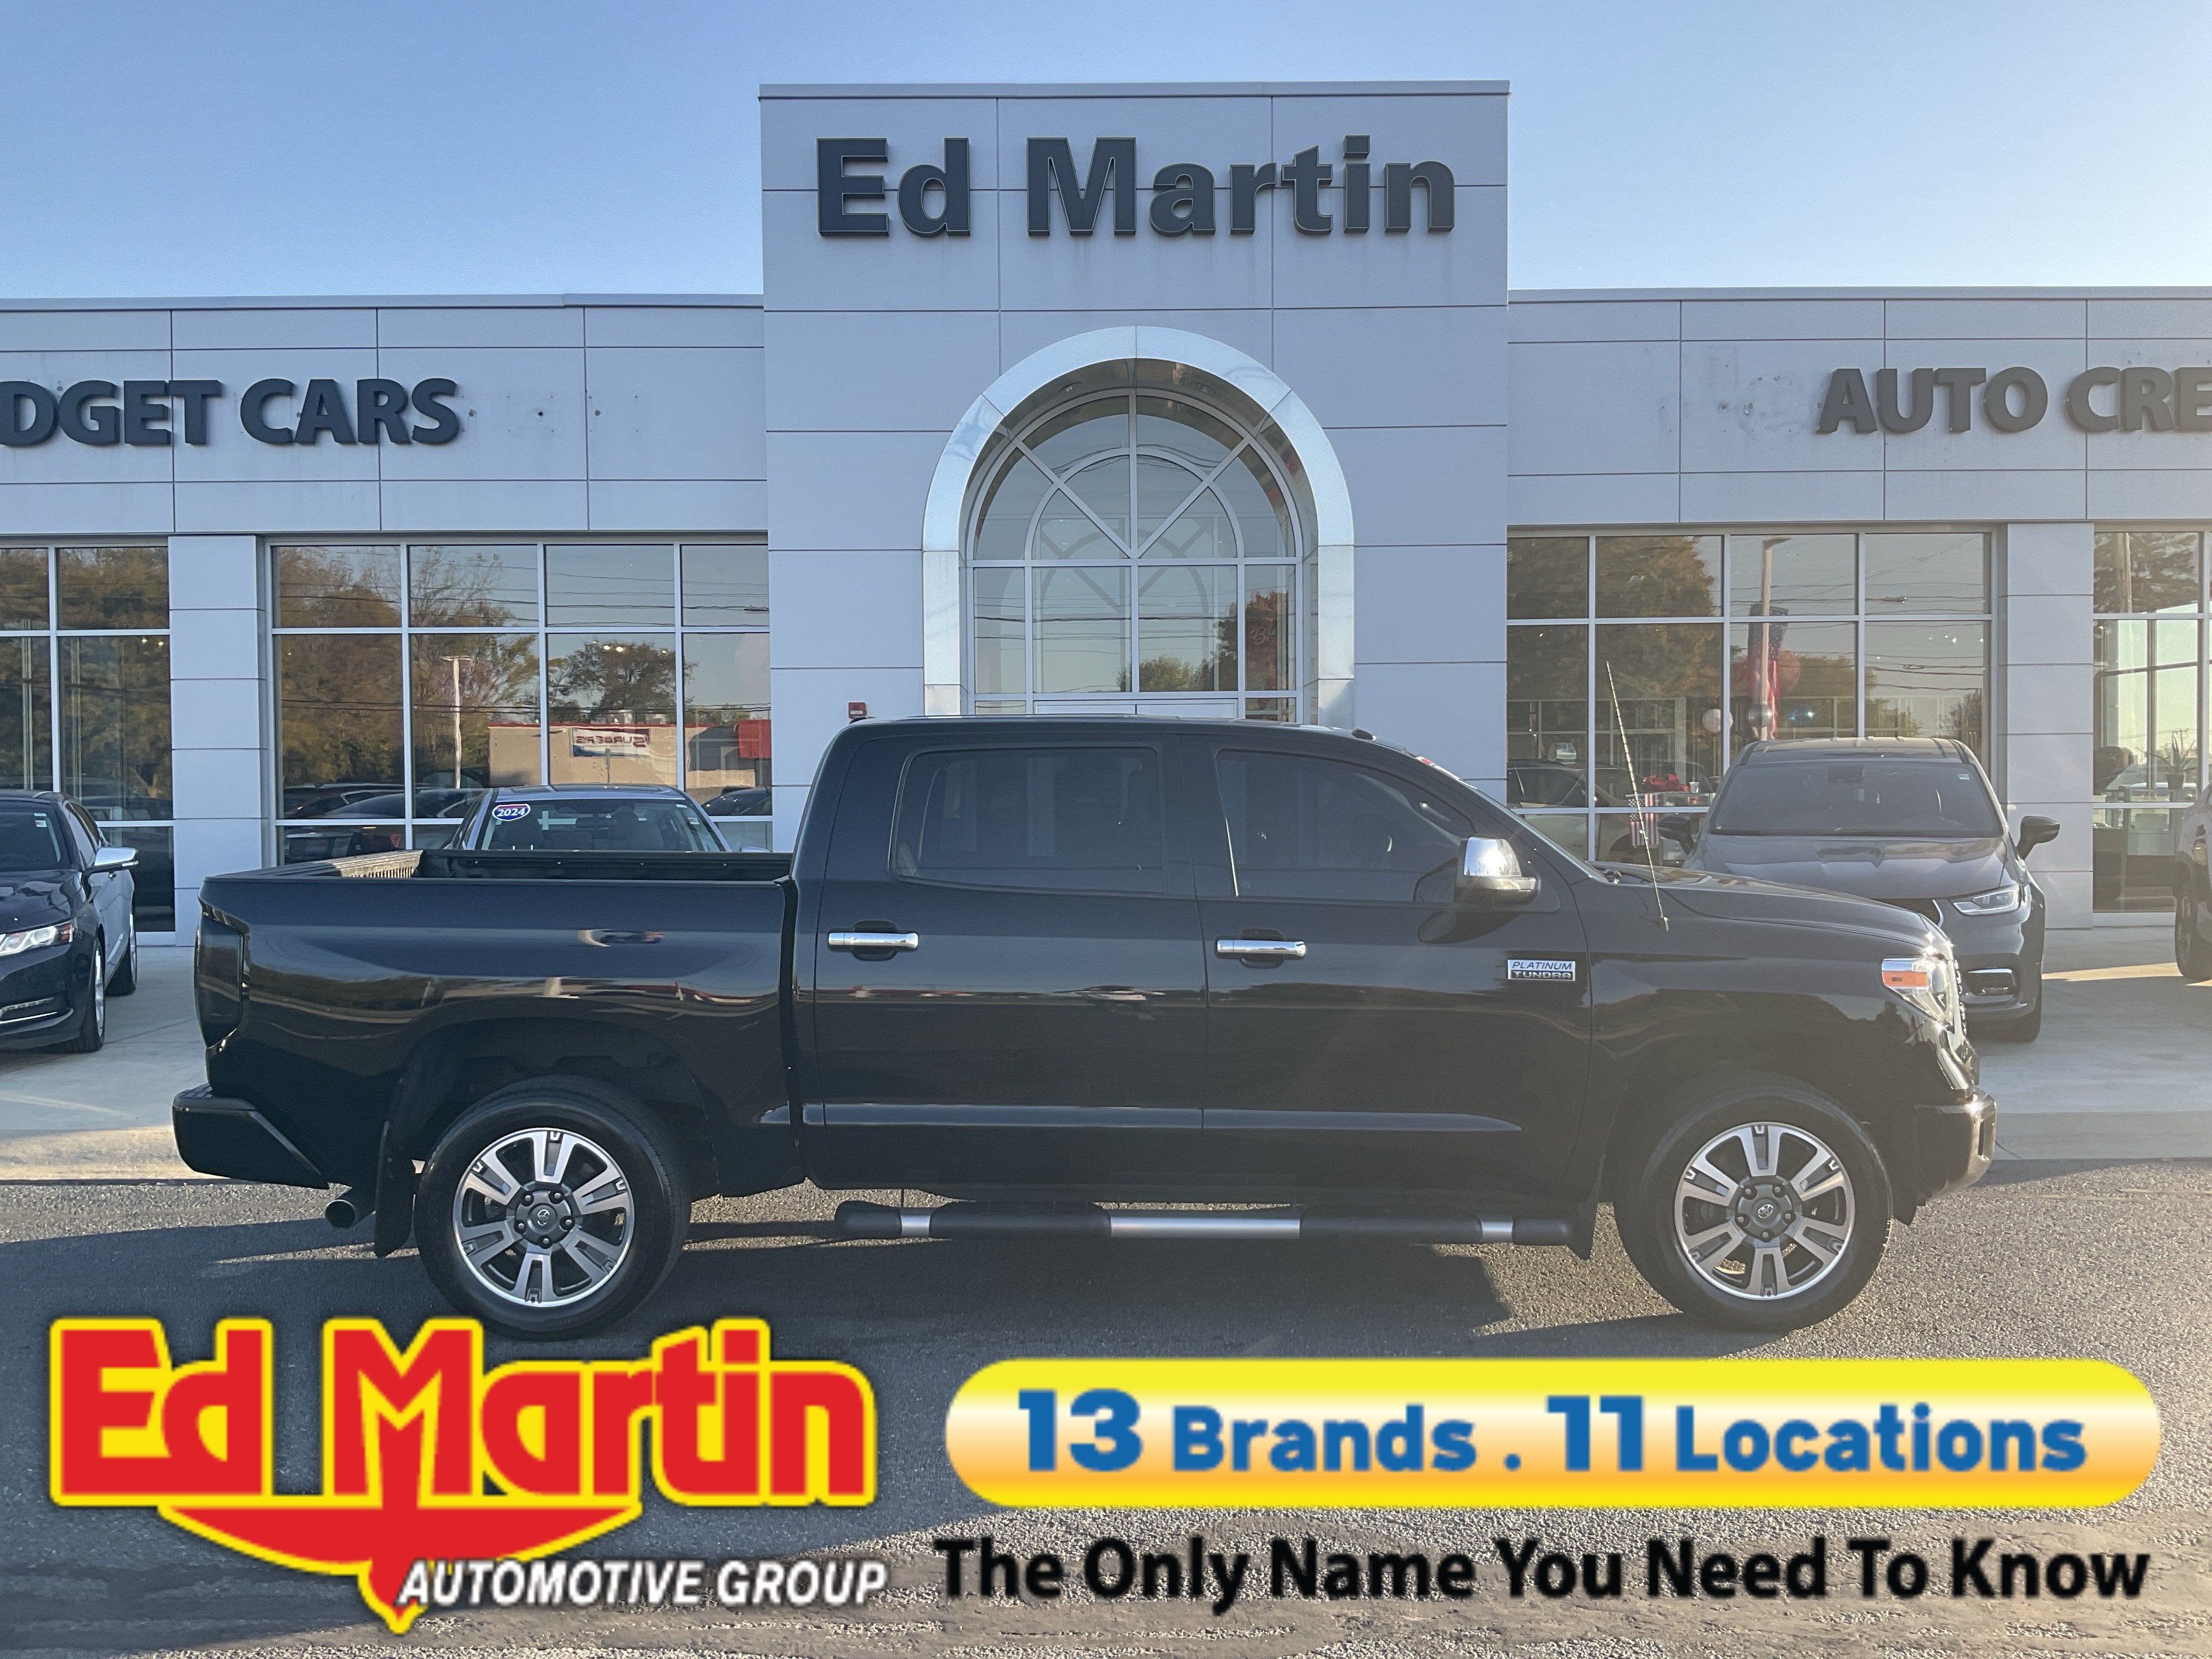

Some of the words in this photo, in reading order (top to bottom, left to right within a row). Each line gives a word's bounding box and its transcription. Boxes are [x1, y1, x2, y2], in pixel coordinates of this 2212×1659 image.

[816, 137, 970, 238] Ed
[1026, 135, 1455, 238] Martin
[0, 380, 222, 447] DGET
[240, 379, 461, 445] CARS
[1816, 366, 2049, 434] AUTO
[497, 808, 526, 817] 2024
[1512, 961, 1572, 970] PLATINUM
[1513, 971, 1572, 979] TUNDRA
